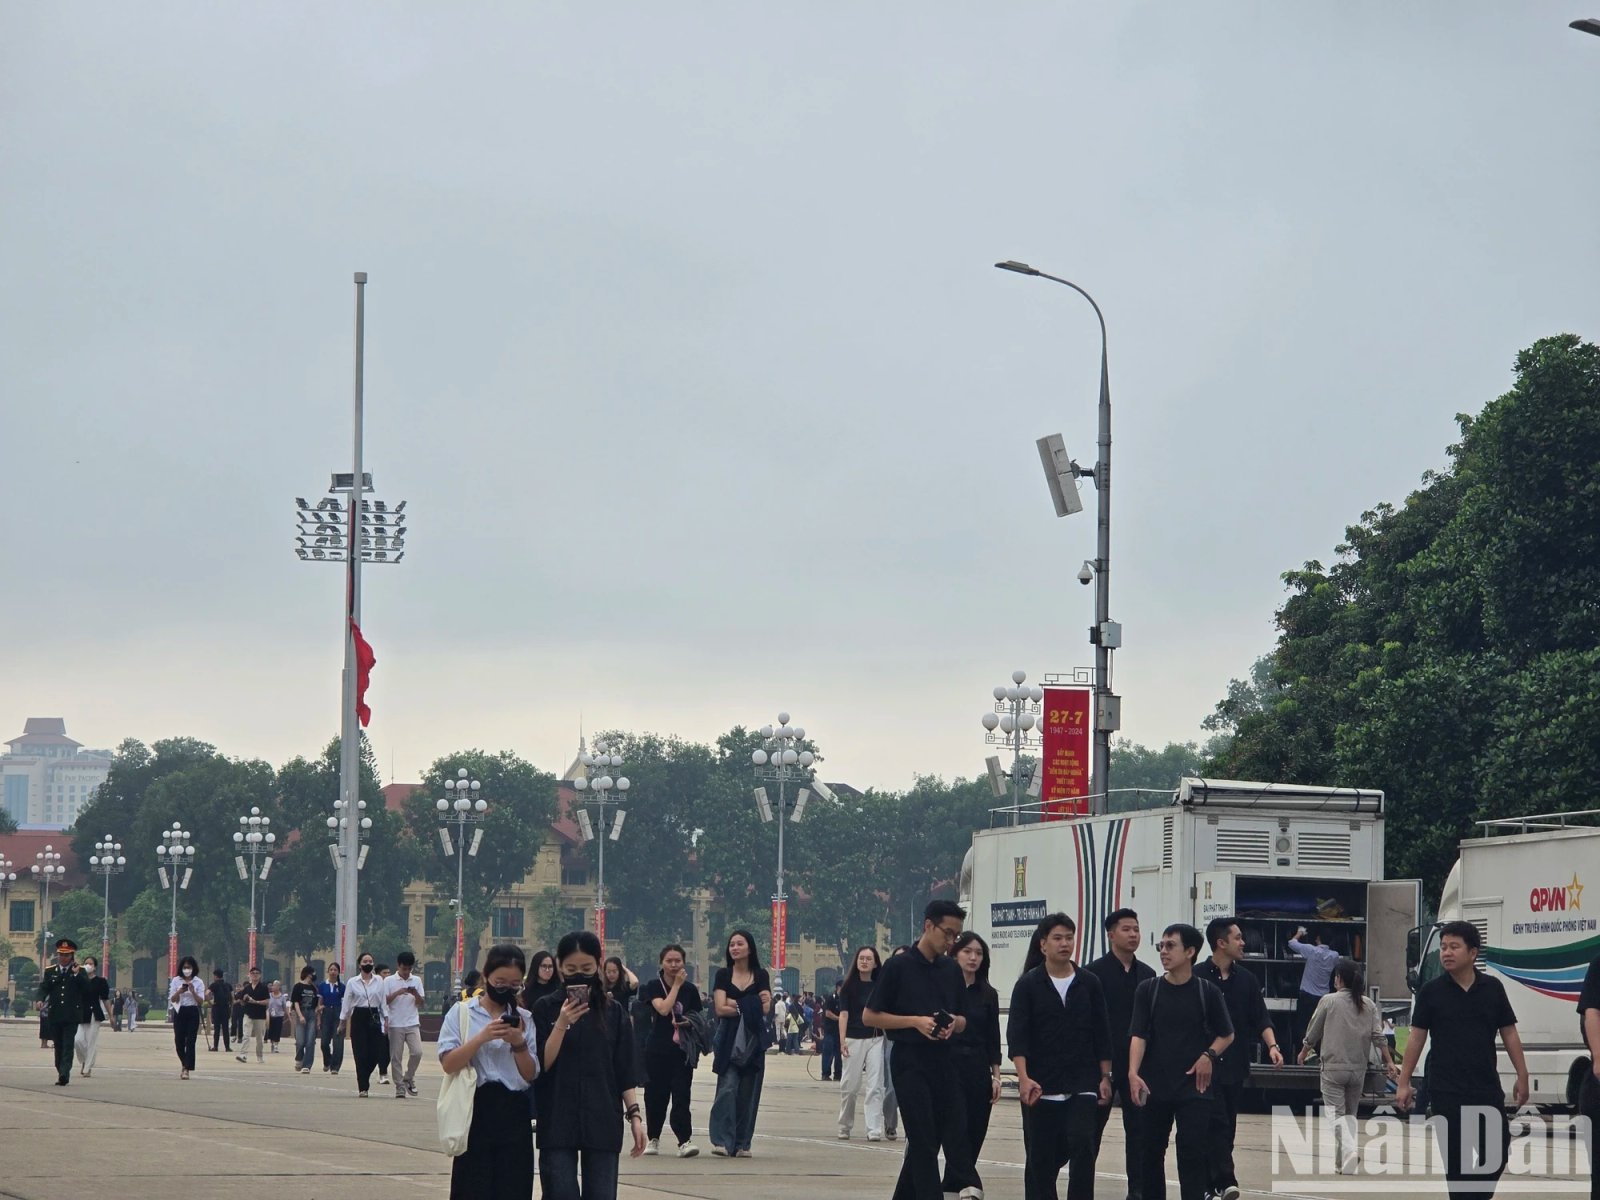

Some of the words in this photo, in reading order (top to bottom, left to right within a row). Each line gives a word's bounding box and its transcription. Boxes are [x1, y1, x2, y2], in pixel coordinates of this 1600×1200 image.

[1049, 709, 1083, 725] 27-7
[1049, 726, 1064, 735] 1947
[1068, 727, 1083, 736] 2024
[1530, 887, 1566, 912] QPVN
[1587, 919, 1596, 931] NAM
